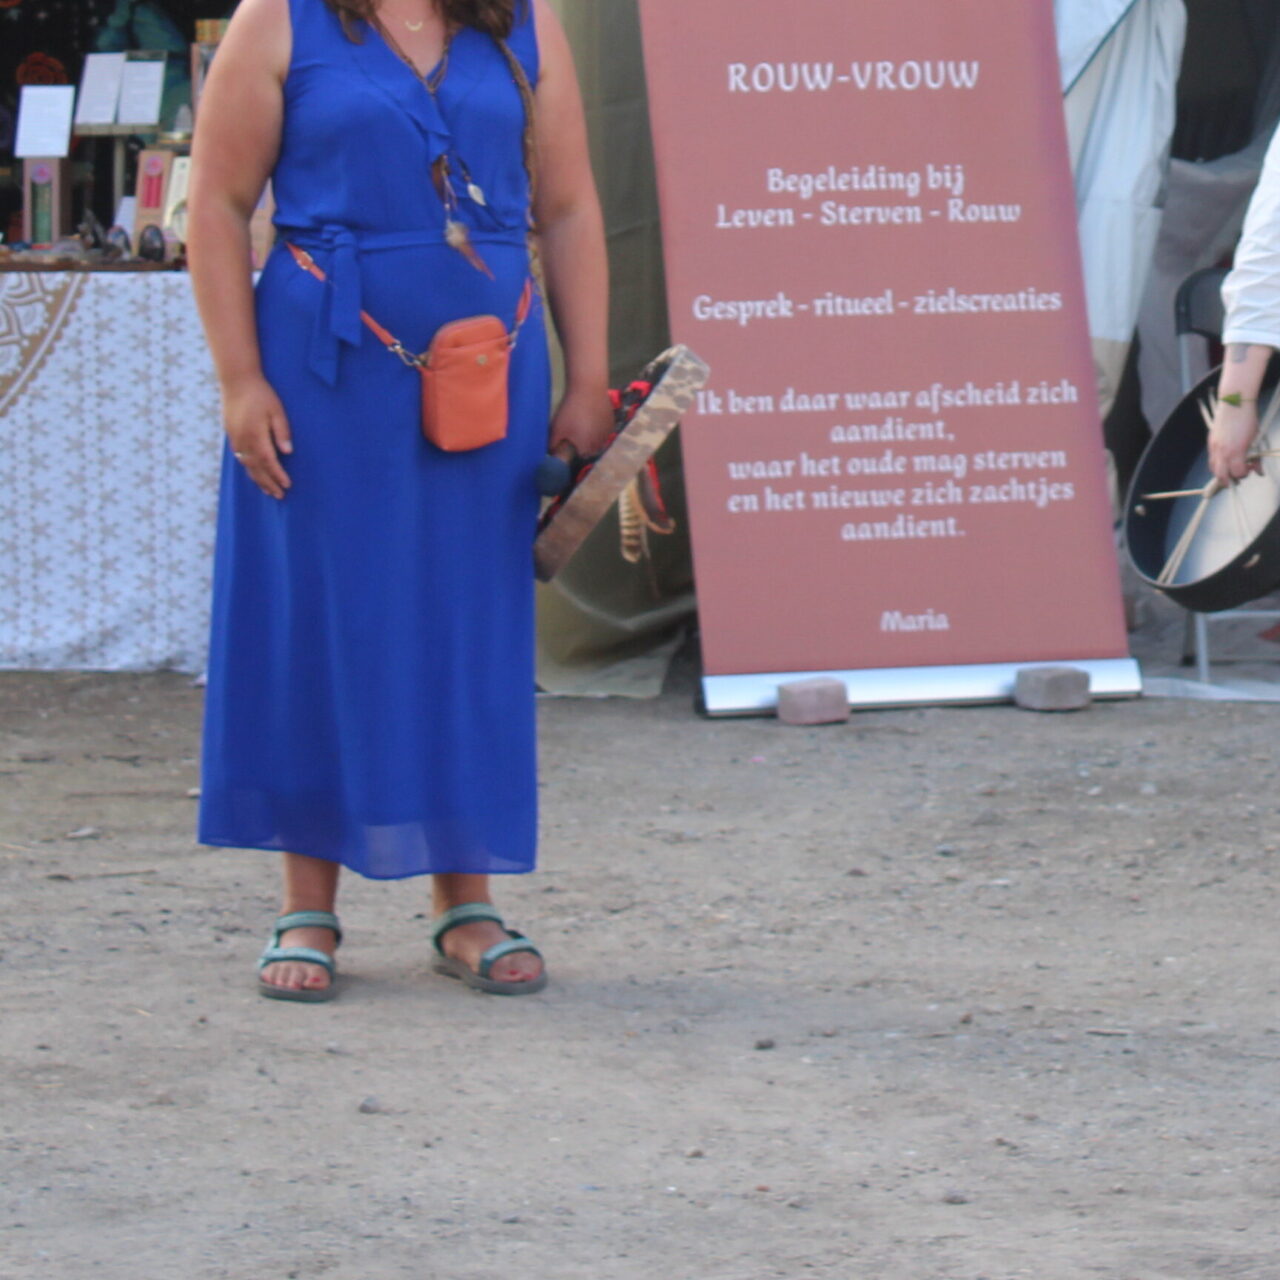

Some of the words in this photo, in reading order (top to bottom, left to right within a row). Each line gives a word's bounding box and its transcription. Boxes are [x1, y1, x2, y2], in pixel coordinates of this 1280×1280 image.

[727, 60, 979, 93] ROUW-VROUW
[767, 164, 922, 199] Begeleiding
[926, 163, 965, 194] bij
[715, 204, 795, 229] Leven
[820, 201, 923, 227] Sterven
[947, 198, 1022, 223] Rouw
[692, 291, 794, 327] Gesprek
[812, 288, 895, 317] ritueel
[913, 287, 1063, 315] zielscreaties
[697, 390, 723, 415] Ik
[727, 389, 775, 415] ben
[779, 387, 840, 413] daar
[844, 390, 911, 411] waar
[915, 381, 1022, 412] afscheid
[1026, 378, 1078, 405] zich
[829, 417, 955, 443] aandient,
[727, 459, 797, 480] waar
[799, 453, 841, 476] het
[846, 450, 907, 475] oude
[912, 453, 968, 478] mag
[973, 450, 1067, 470] sterven
[727, 494, 760, 513] en
[765, 487, 806, 511] het
[811, 485, 905, 509] nieuwe
[911, 481, 964, 505] zich
[968, 478, 1075, 508] zachtjes
[840, 515, 965, 542] aandient.
[879, 608, 950, 632] Maria
